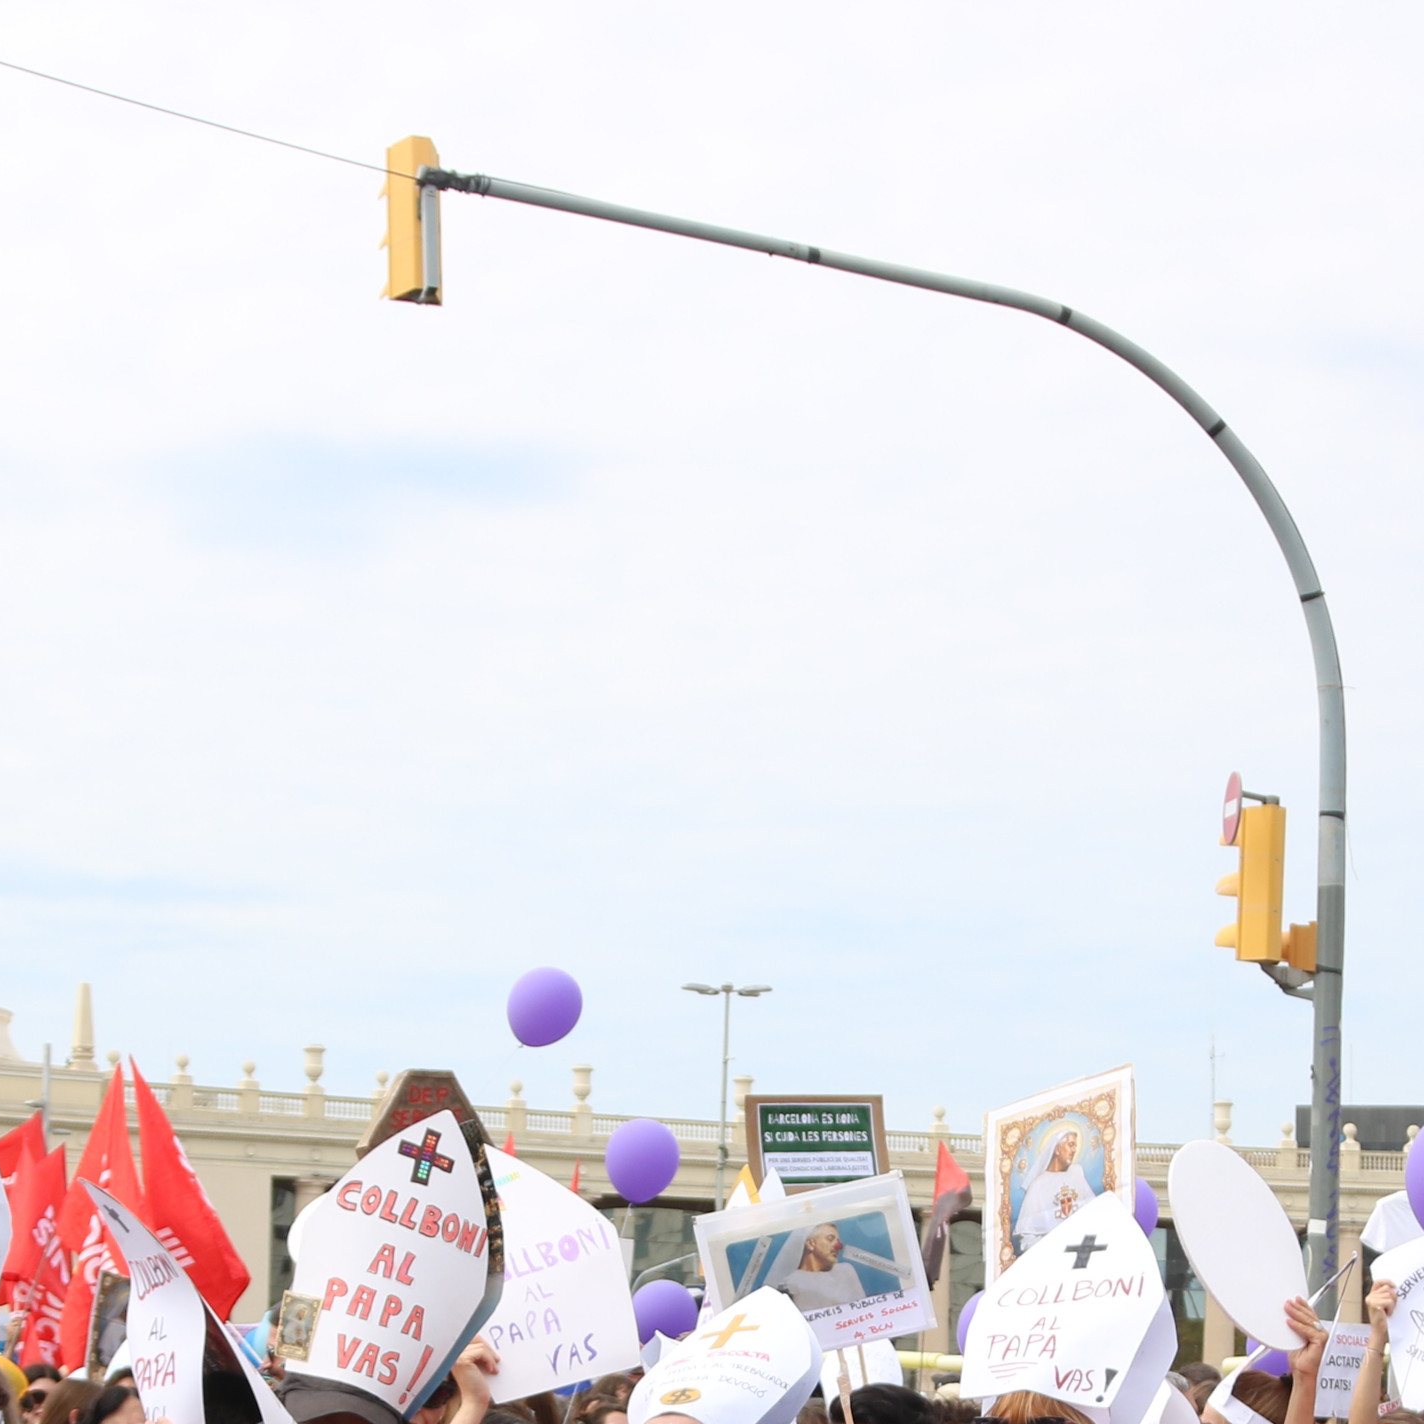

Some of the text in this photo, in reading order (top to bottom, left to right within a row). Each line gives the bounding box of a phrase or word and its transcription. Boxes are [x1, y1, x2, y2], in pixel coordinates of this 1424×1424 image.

[407, 1085, 452, 1104] DEP
[768, 1113, 820, 1125] BARCELONA
[802, 1131, 820, 1142] LES
[822, 1130, 869, 1142] PERSONES
[337, 1179, 490, 1258] COLLBONI
[367, 1243, 416, 1286] AL
[523, 1282, 554, 1303] AL
[893, 1290, 905, 1300] DE
[321, 1276, 425, 1341] PAPA
[835, 1312, 875, 1331] SERVEIS
[148, 1316, 168, 1342] AL
[489, 1307, 562, 1350] PAPA
[1030, 1315, 1063, 1331] AL
[546, 1333, 598, 1375] VAS
[987, 1333, 1057, 1361] PAPA
[135, 1350, 176, 1393] PAPA
